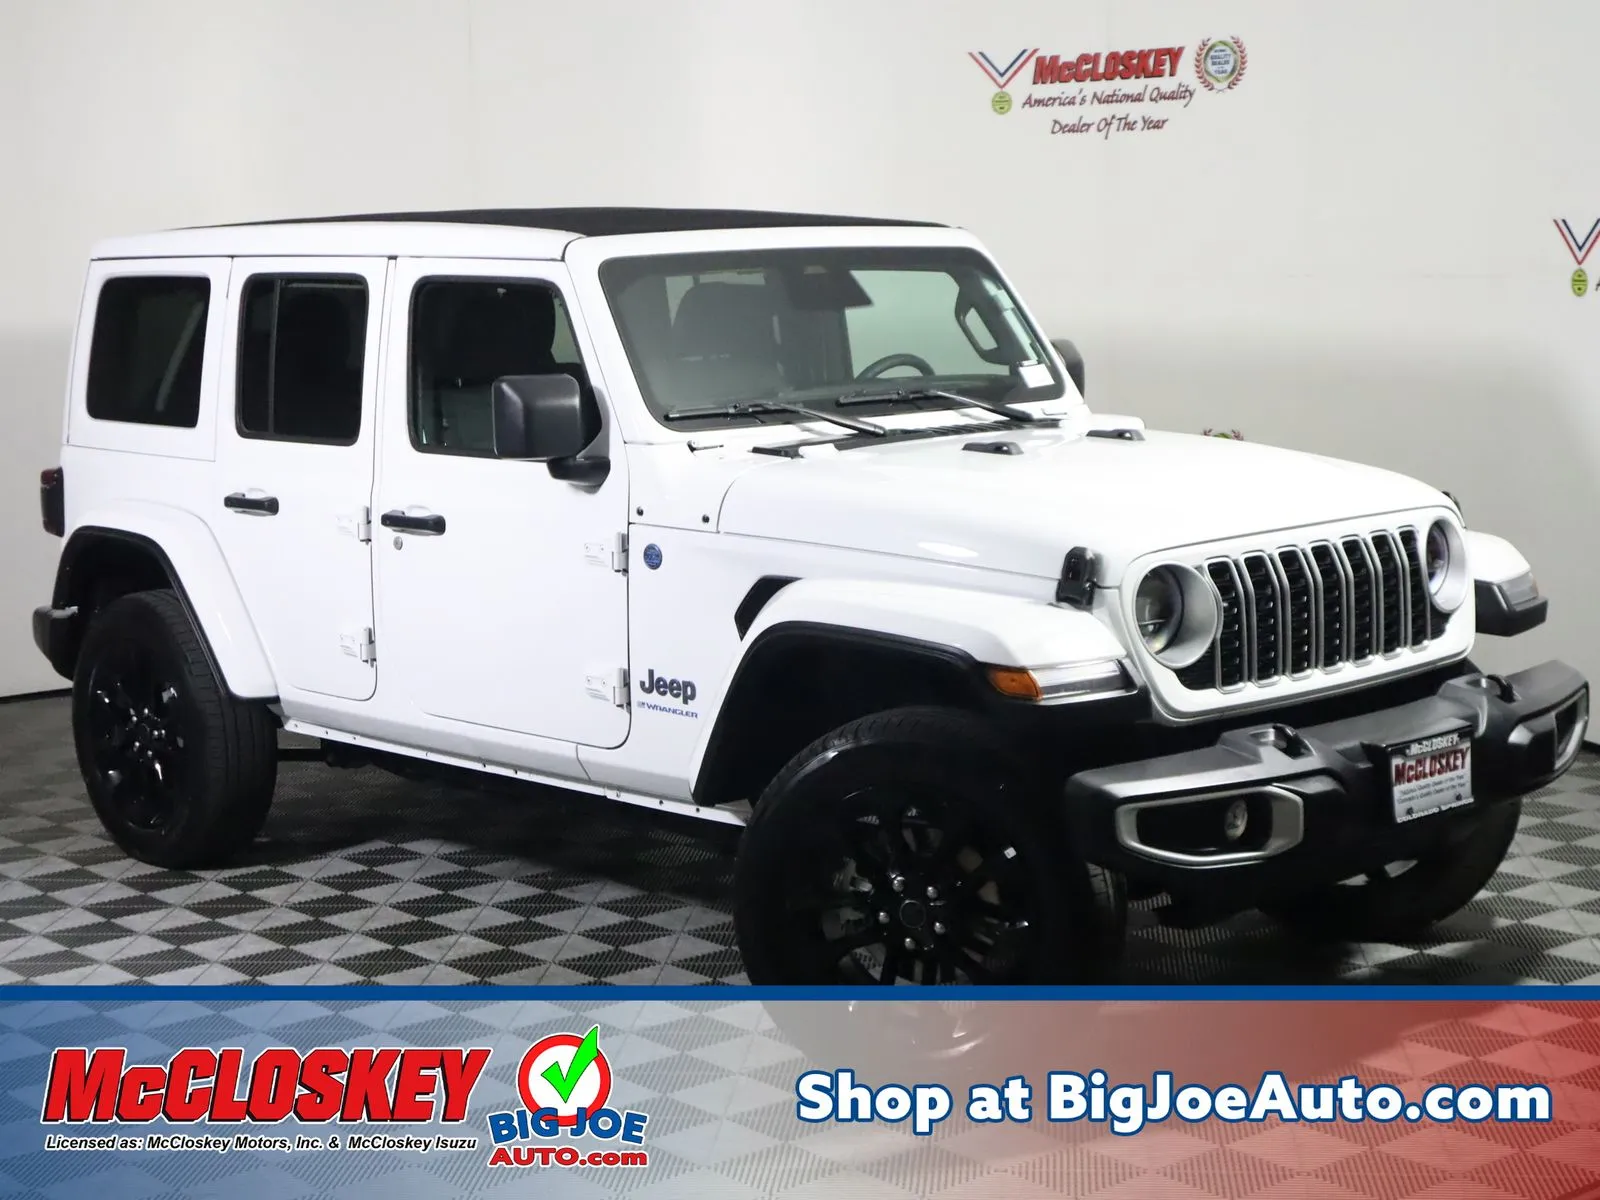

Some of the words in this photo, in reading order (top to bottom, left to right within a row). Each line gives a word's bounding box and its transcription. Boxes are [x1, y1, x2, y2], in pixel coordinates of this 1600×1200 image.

[1032, 46, 1185, 85] McCLOSKEY
[1021, 88, 1087, 109] America's
[1090, 85, 1145, 106] National
[1149, 82, 1197, 108] Quality
[1050, 115, 1095, 135] Dealer
[1097, 114, 1116, 140] Of
[1116, 114, 1137, 132] The
[1141, 114, 1169, 131] Year
[639, 668, 697, 705] Jeep
[646, 702, 698, 719] WRANGLER
[1394, 746, 1470, 786] McCLOSKEY
